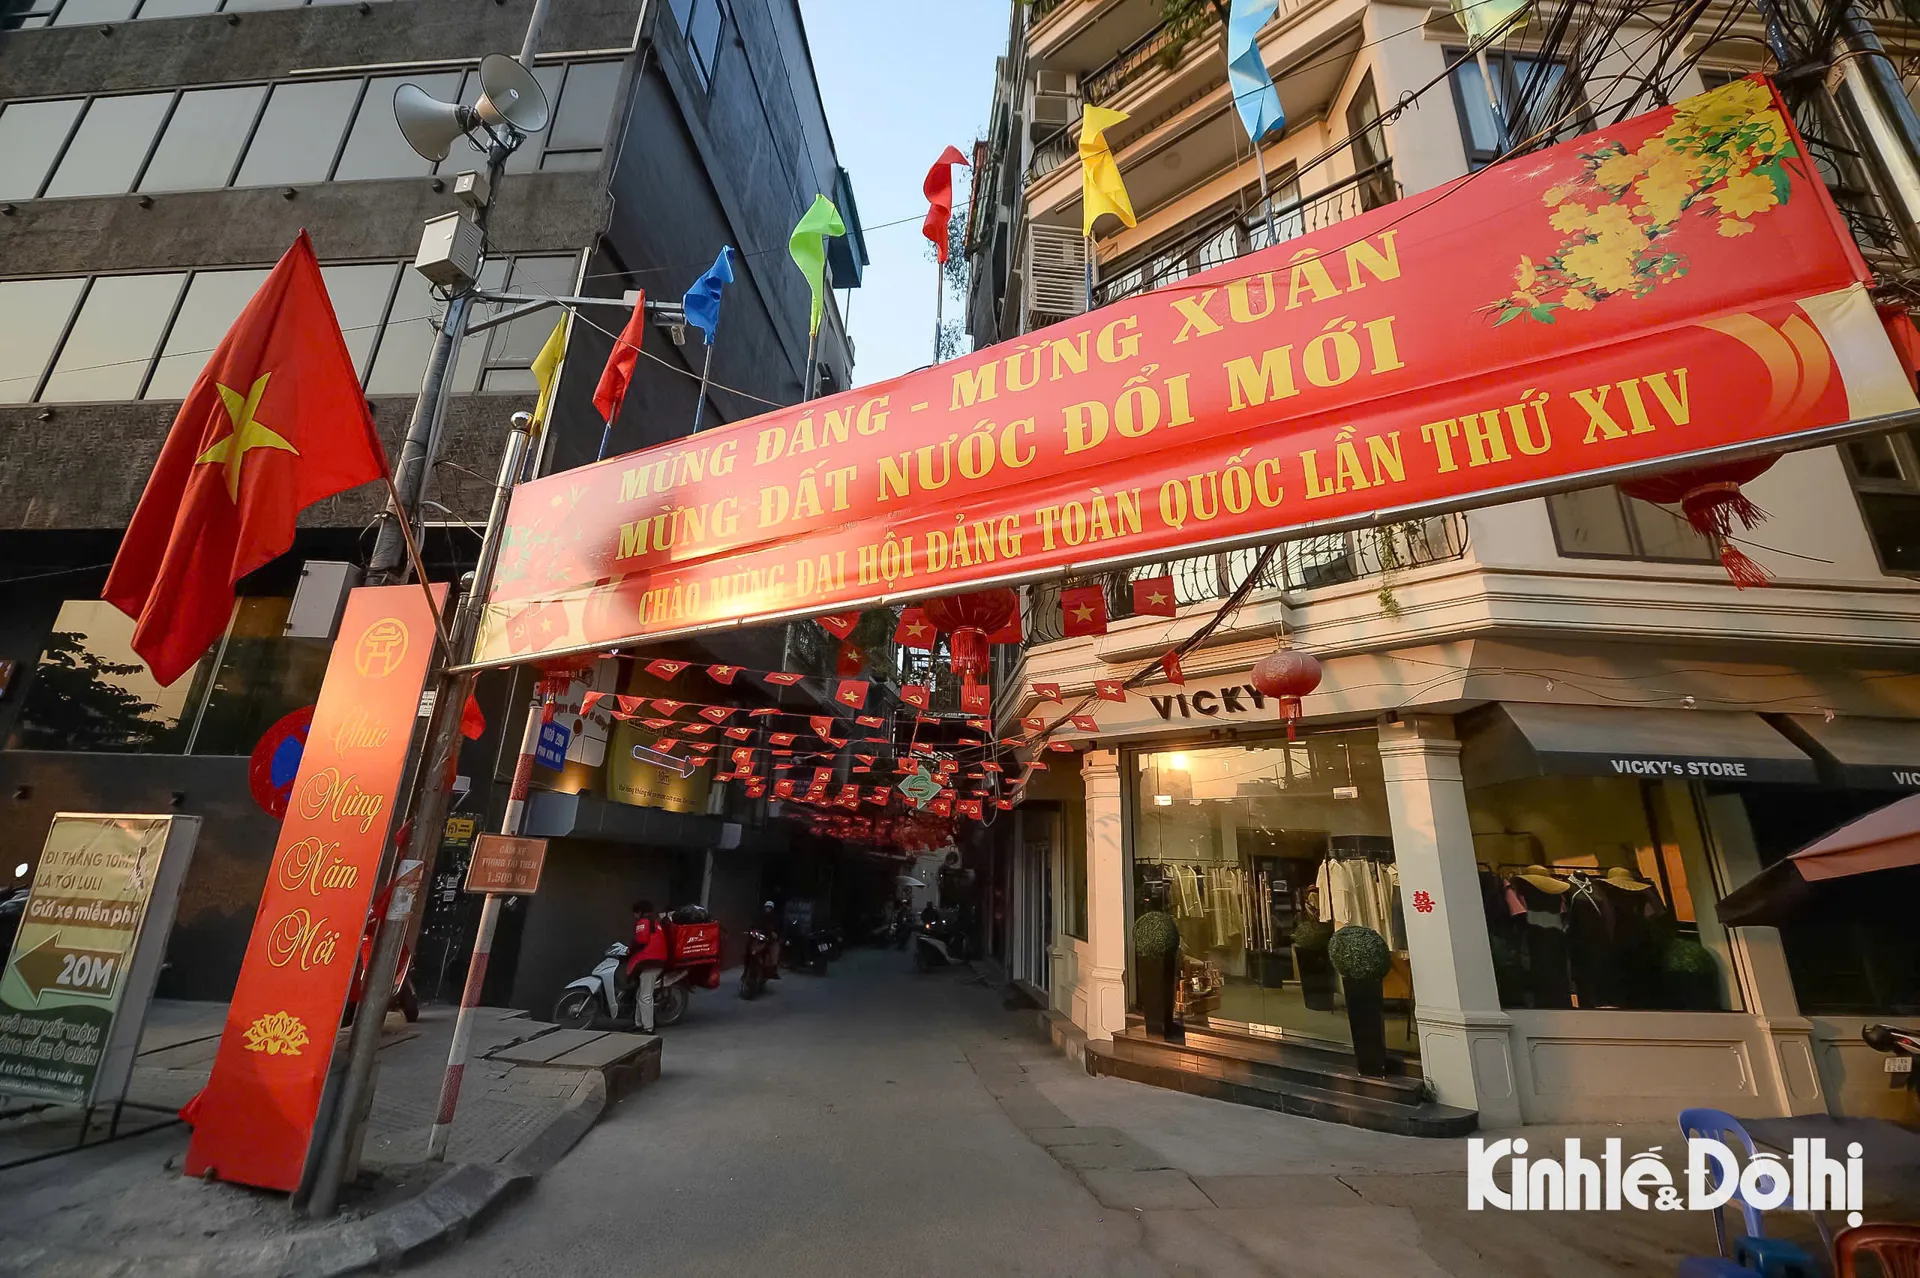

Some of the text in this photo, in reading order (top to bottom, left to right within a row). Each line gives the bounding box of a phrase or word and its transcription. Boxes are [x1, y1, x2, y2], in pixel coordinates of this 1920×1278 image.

[617, 438, 738, 503] MỪNG
[753, 395, 891, 466] ĐẢNG
[948, 314, 1142, 412] MỪNG
[1169, 229, 1401, 344] XUÂN
[615, 315, 1405, 560] MỪNG ĐẤT NƯỚC ĐỔI MỚI
[638, 367, 1691, 626] CHÀO MỪNG ĐẠI HỘI ĐẢNG TOÀN QUỐC LẦN THỨ XIV
[1149, 683, 1266, 720] VICKY
[1610, 759, 1748, 777] VICKY's STORE
[299, 767, 384, 834] Mừng
[279, 836, 359, 896] Năm
[56, 905, 73, 919] xe
[110, 903, 140, 926] phí
[267, 907, 341, 972] Mới
[56, 954, 115, 989] 20M
